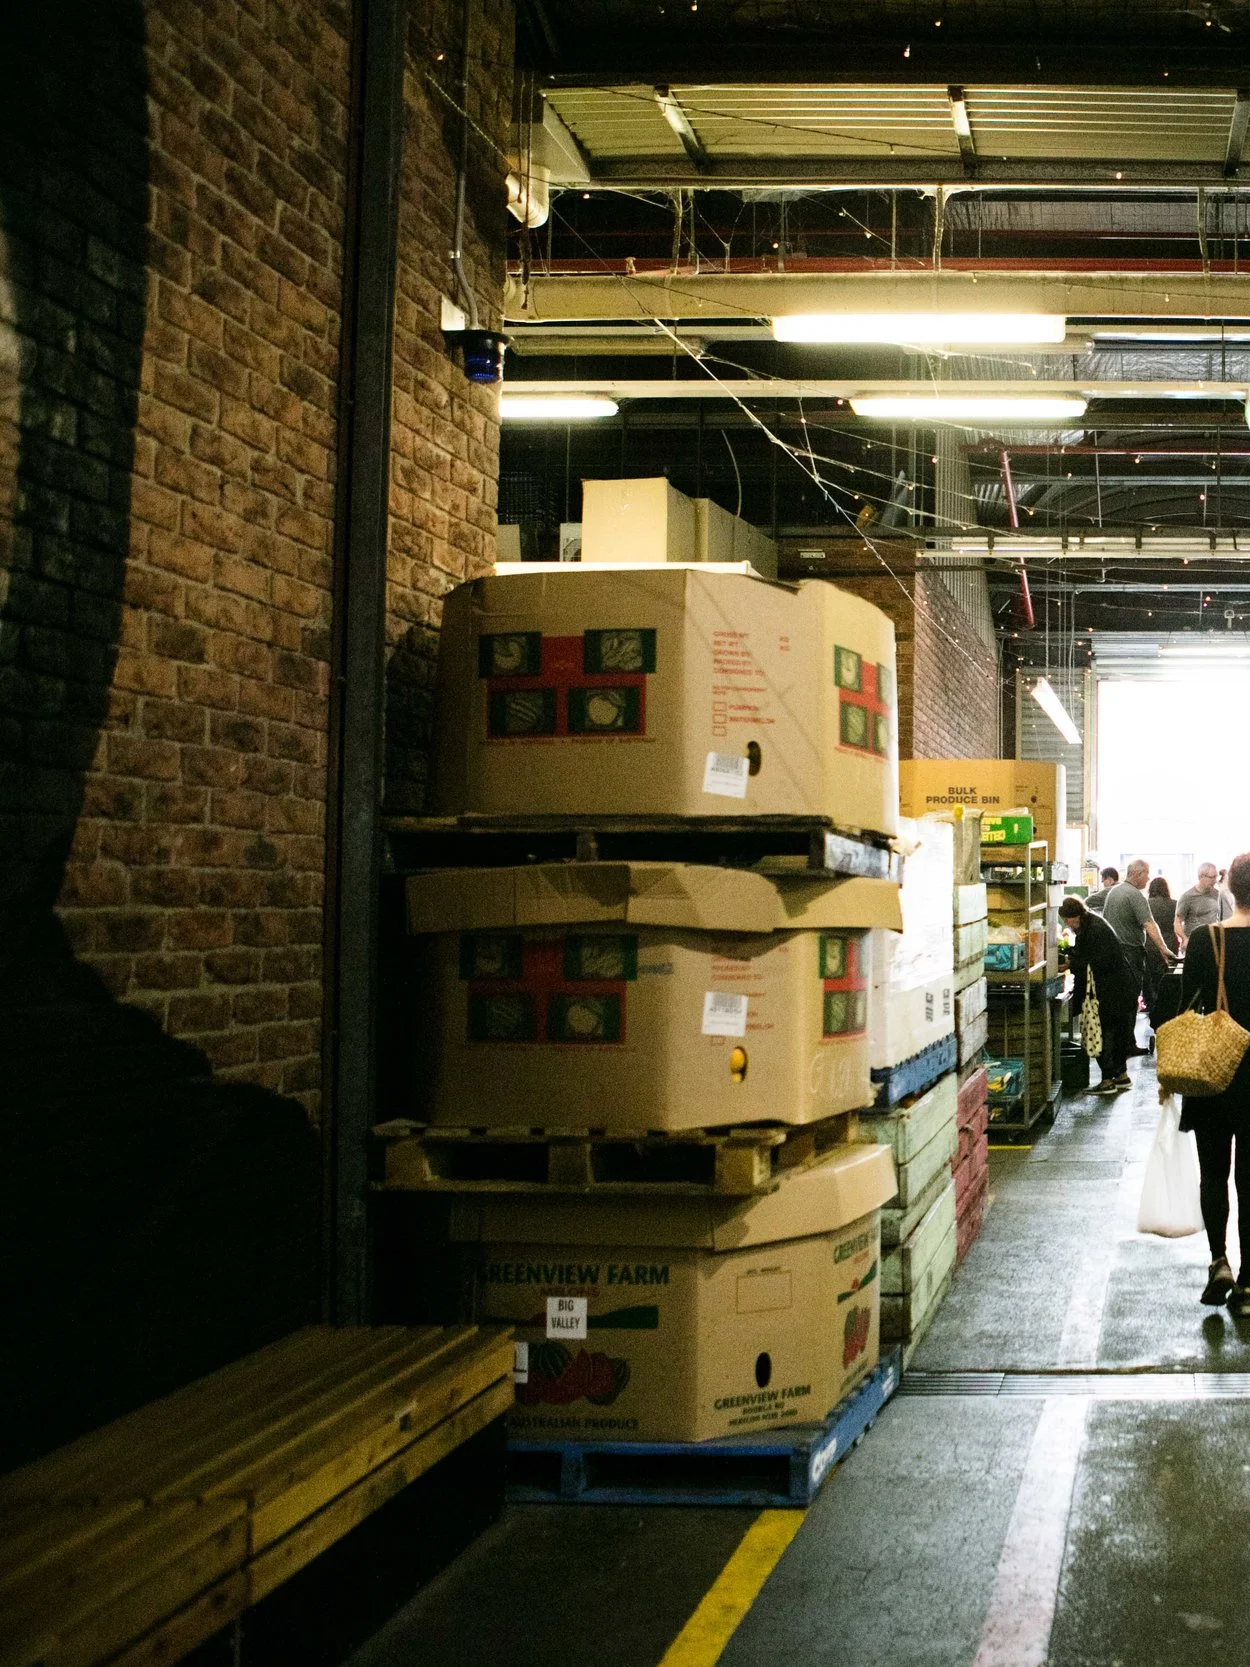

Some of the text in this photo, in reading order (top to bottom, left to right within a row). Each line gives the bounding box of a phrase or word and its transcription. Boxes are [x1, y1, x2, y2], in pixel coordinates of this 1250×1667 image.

[948, 786, 977, 795] BULK
[926, 795, 1000, 804] PRODUCE BIN
[476, 1264, 670, 1285] GREENVIEW FARM
[558, 1299, 574, 1312] BIG
[551, 1316, 580, 1330] VALLEY
[714, 1384, 811, 1410] GREENVIEW FARM
[584, 1416, 639, 1430] PRODUCE
